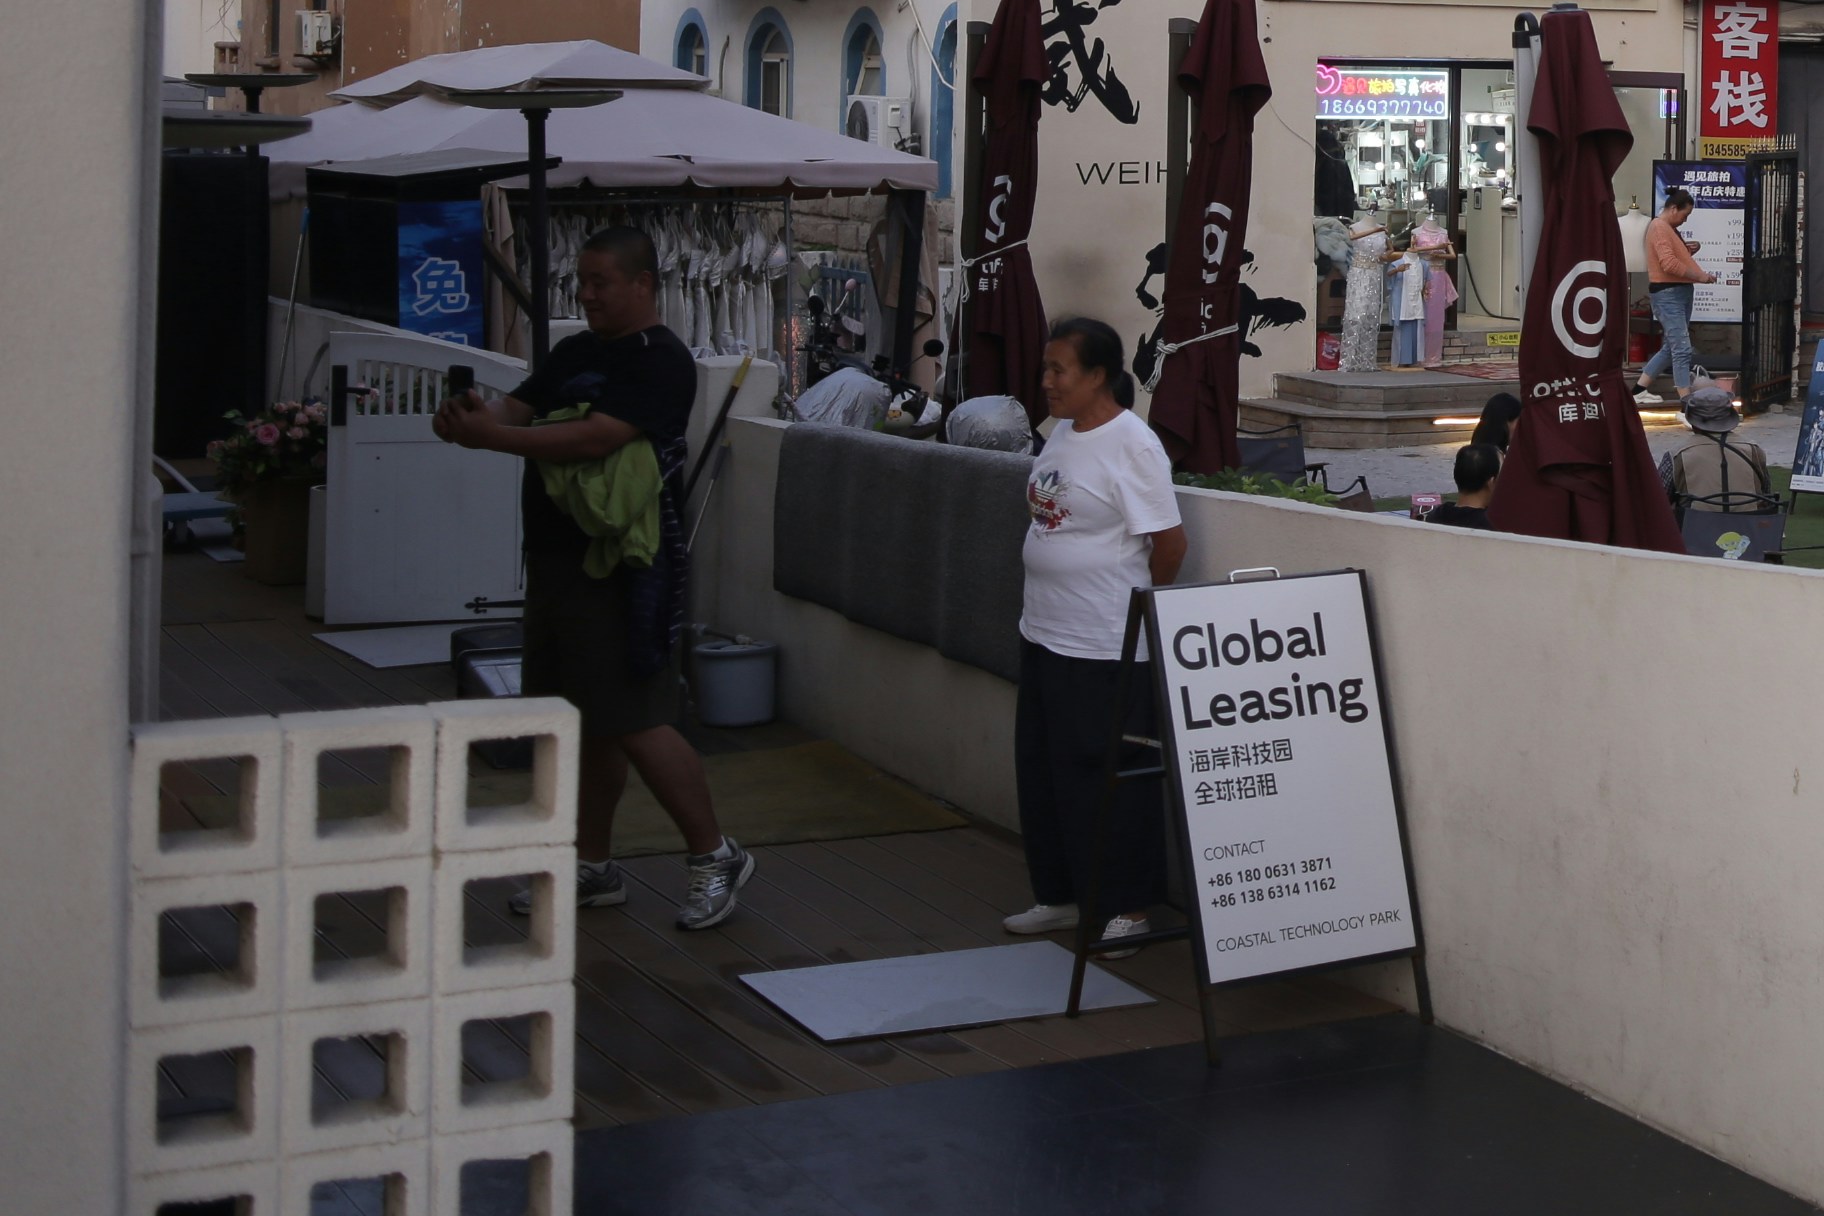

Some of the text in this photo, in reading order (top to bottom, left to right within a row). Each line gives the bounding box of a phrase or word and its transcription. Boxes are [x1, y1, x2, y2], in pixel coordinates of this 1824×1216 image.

[1710, 2, 1769, 128] 客栈
[1321, 99, 1445, 114] 18669377740
[1684, 171, 1731, 182] 遇见旅拍
[1172, 611, 1327, 671] Global
[1180, 672, 1369, 731] Leasing
[1189, 738, 1293, 773] 海岸科技园
[1194, 772, 1279, 806] 全球招租
[1203, 840, 1266, 861] CONTACT
[1208, 857, 1333, 888] +86 180 0631 3871
[1211, 877, 1337, 908] +86 138 6314 1162
[1216, 909, 1402, 953] COASTAL TECHNOLOGY PARK
